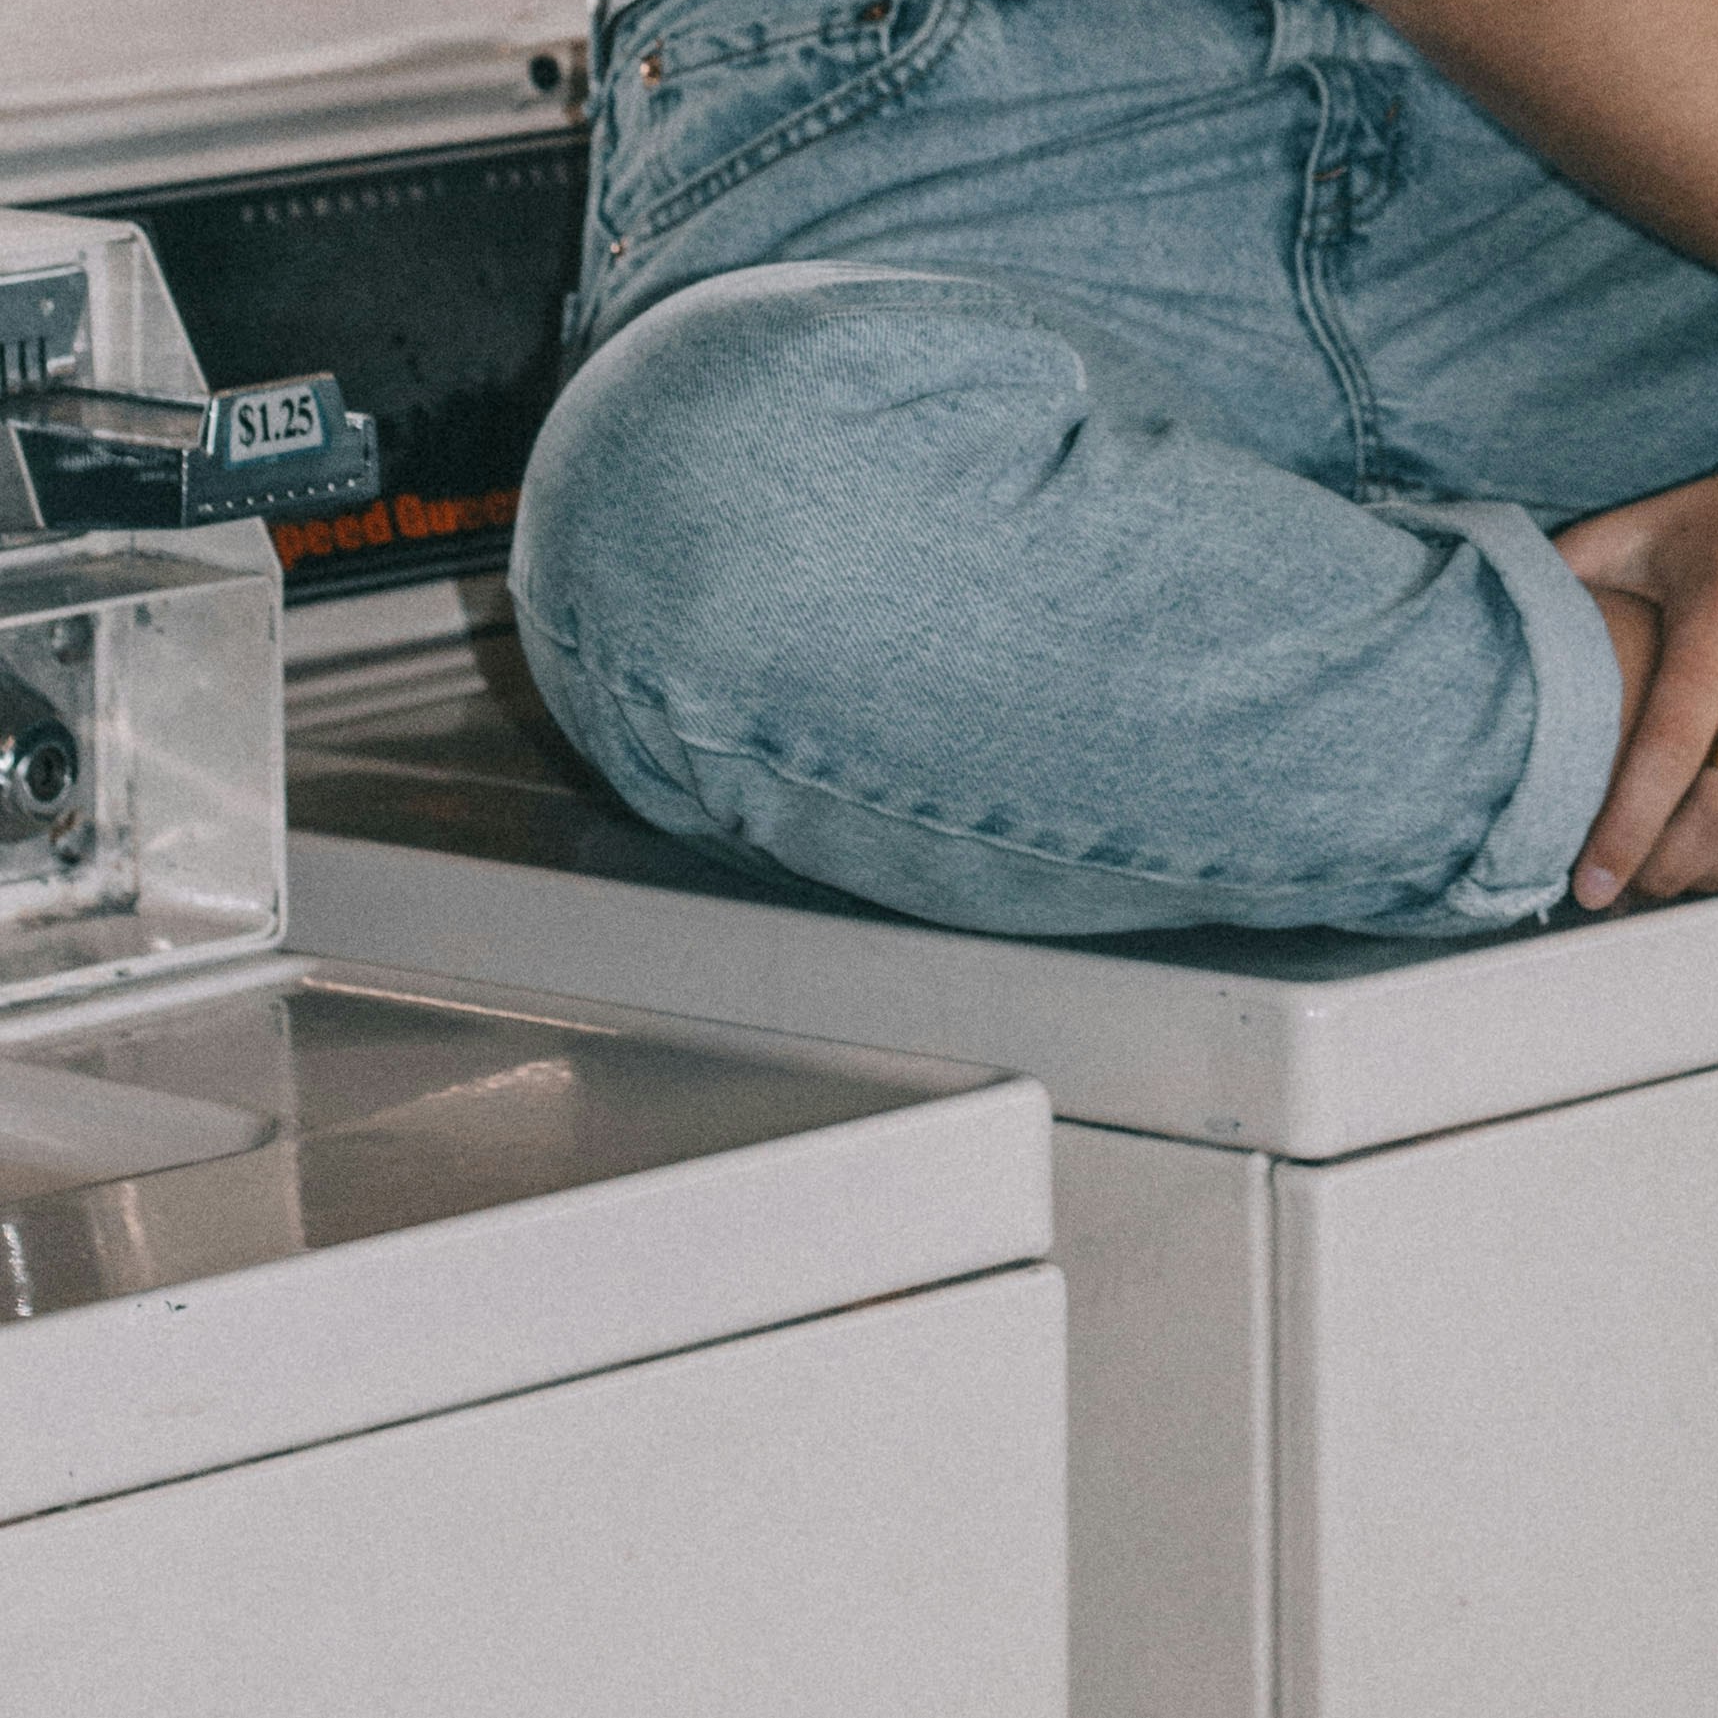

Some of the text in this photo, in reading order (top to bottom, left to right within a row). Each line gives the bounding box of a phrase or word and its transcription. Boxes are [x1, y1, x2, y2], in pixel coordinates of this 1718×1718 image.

[238, 395, 313, 447] $1.25
[275, 492, 518, 570] peed Quee
